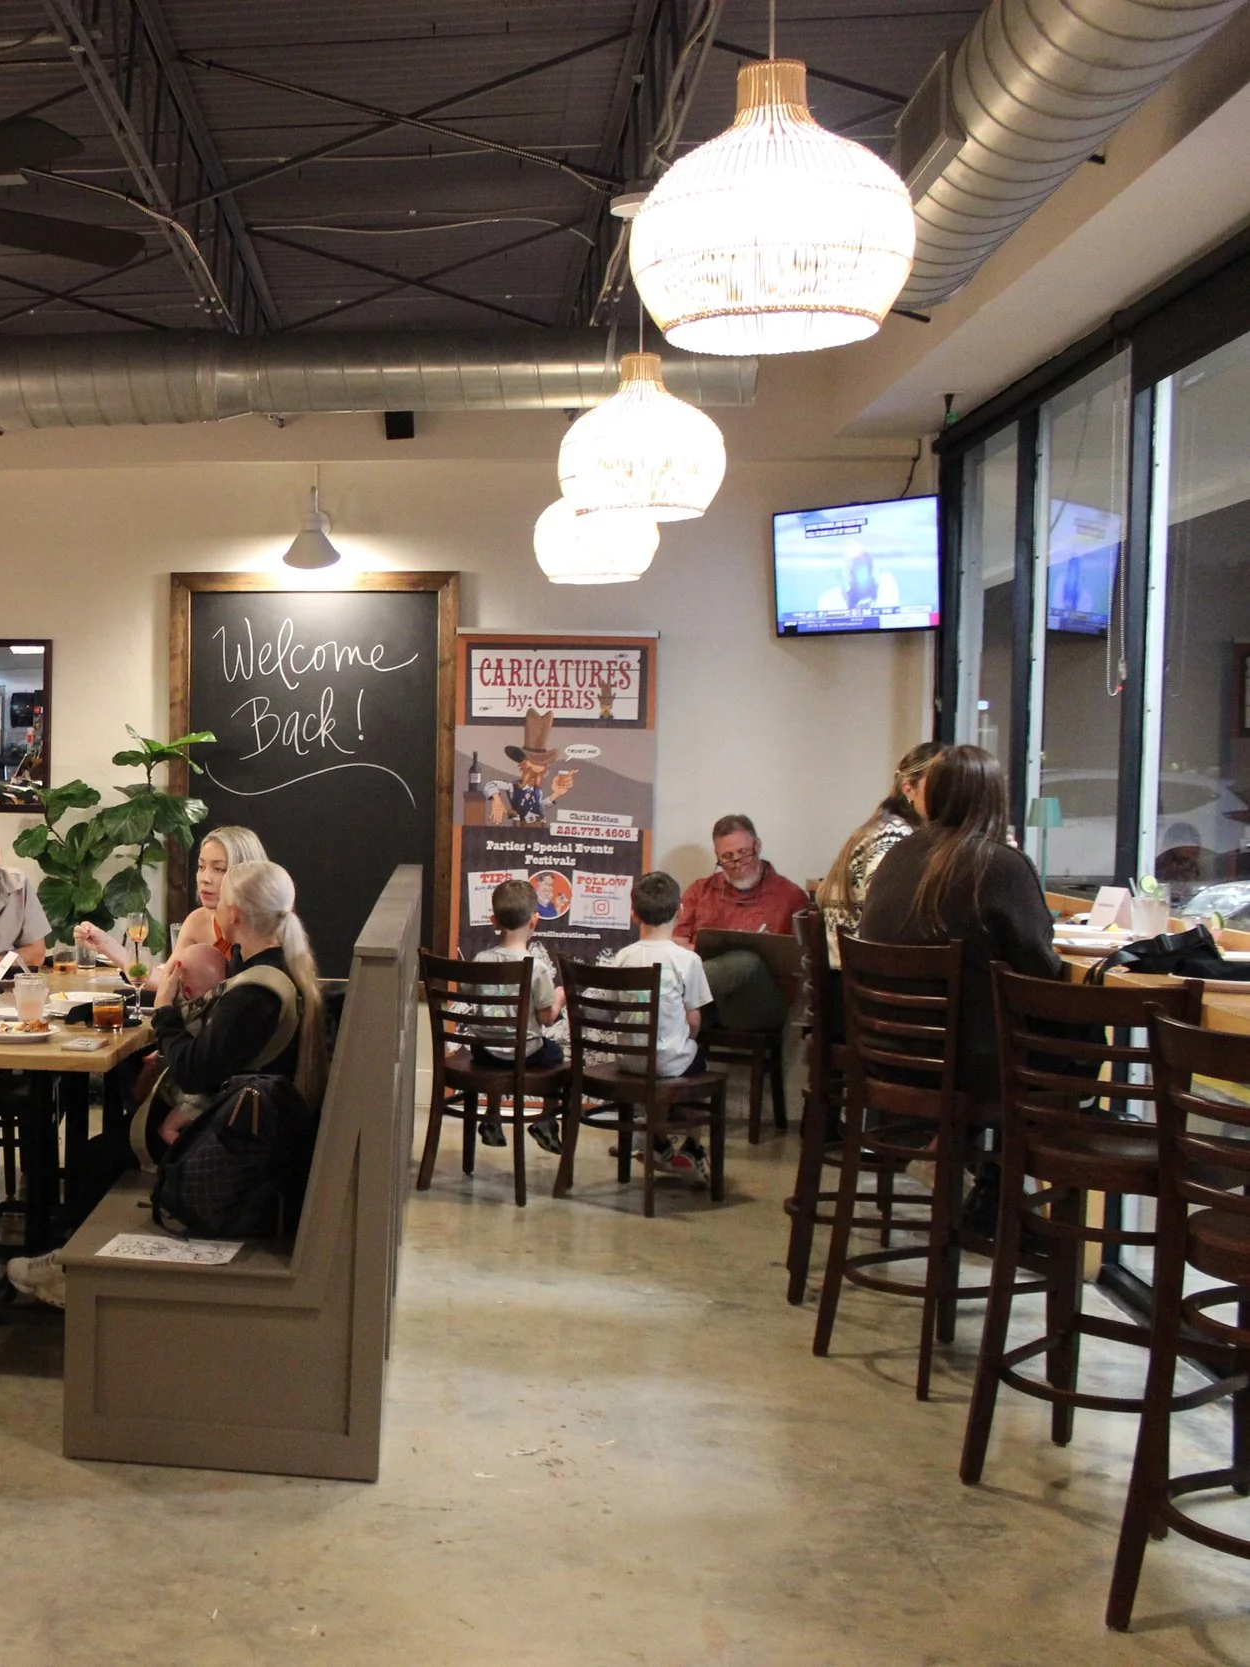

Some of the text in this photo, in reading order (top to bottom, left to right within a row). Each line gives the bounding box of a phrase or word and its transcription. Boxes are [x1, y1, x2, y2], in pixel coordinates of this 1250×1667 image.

[212, 617, 419, 690] Welcome
[479, 657, 632, 690] CARICATURES
[569, 813, 590, 821] Chris
[486, 840, 614, 854] Parties Special Events
[524, 854, 576, 866] Festivals
[480, 873, 513, 884] TIPS
[576, 876, 627, 887] FOLLOW
[584, 885, 604, 894] ME
